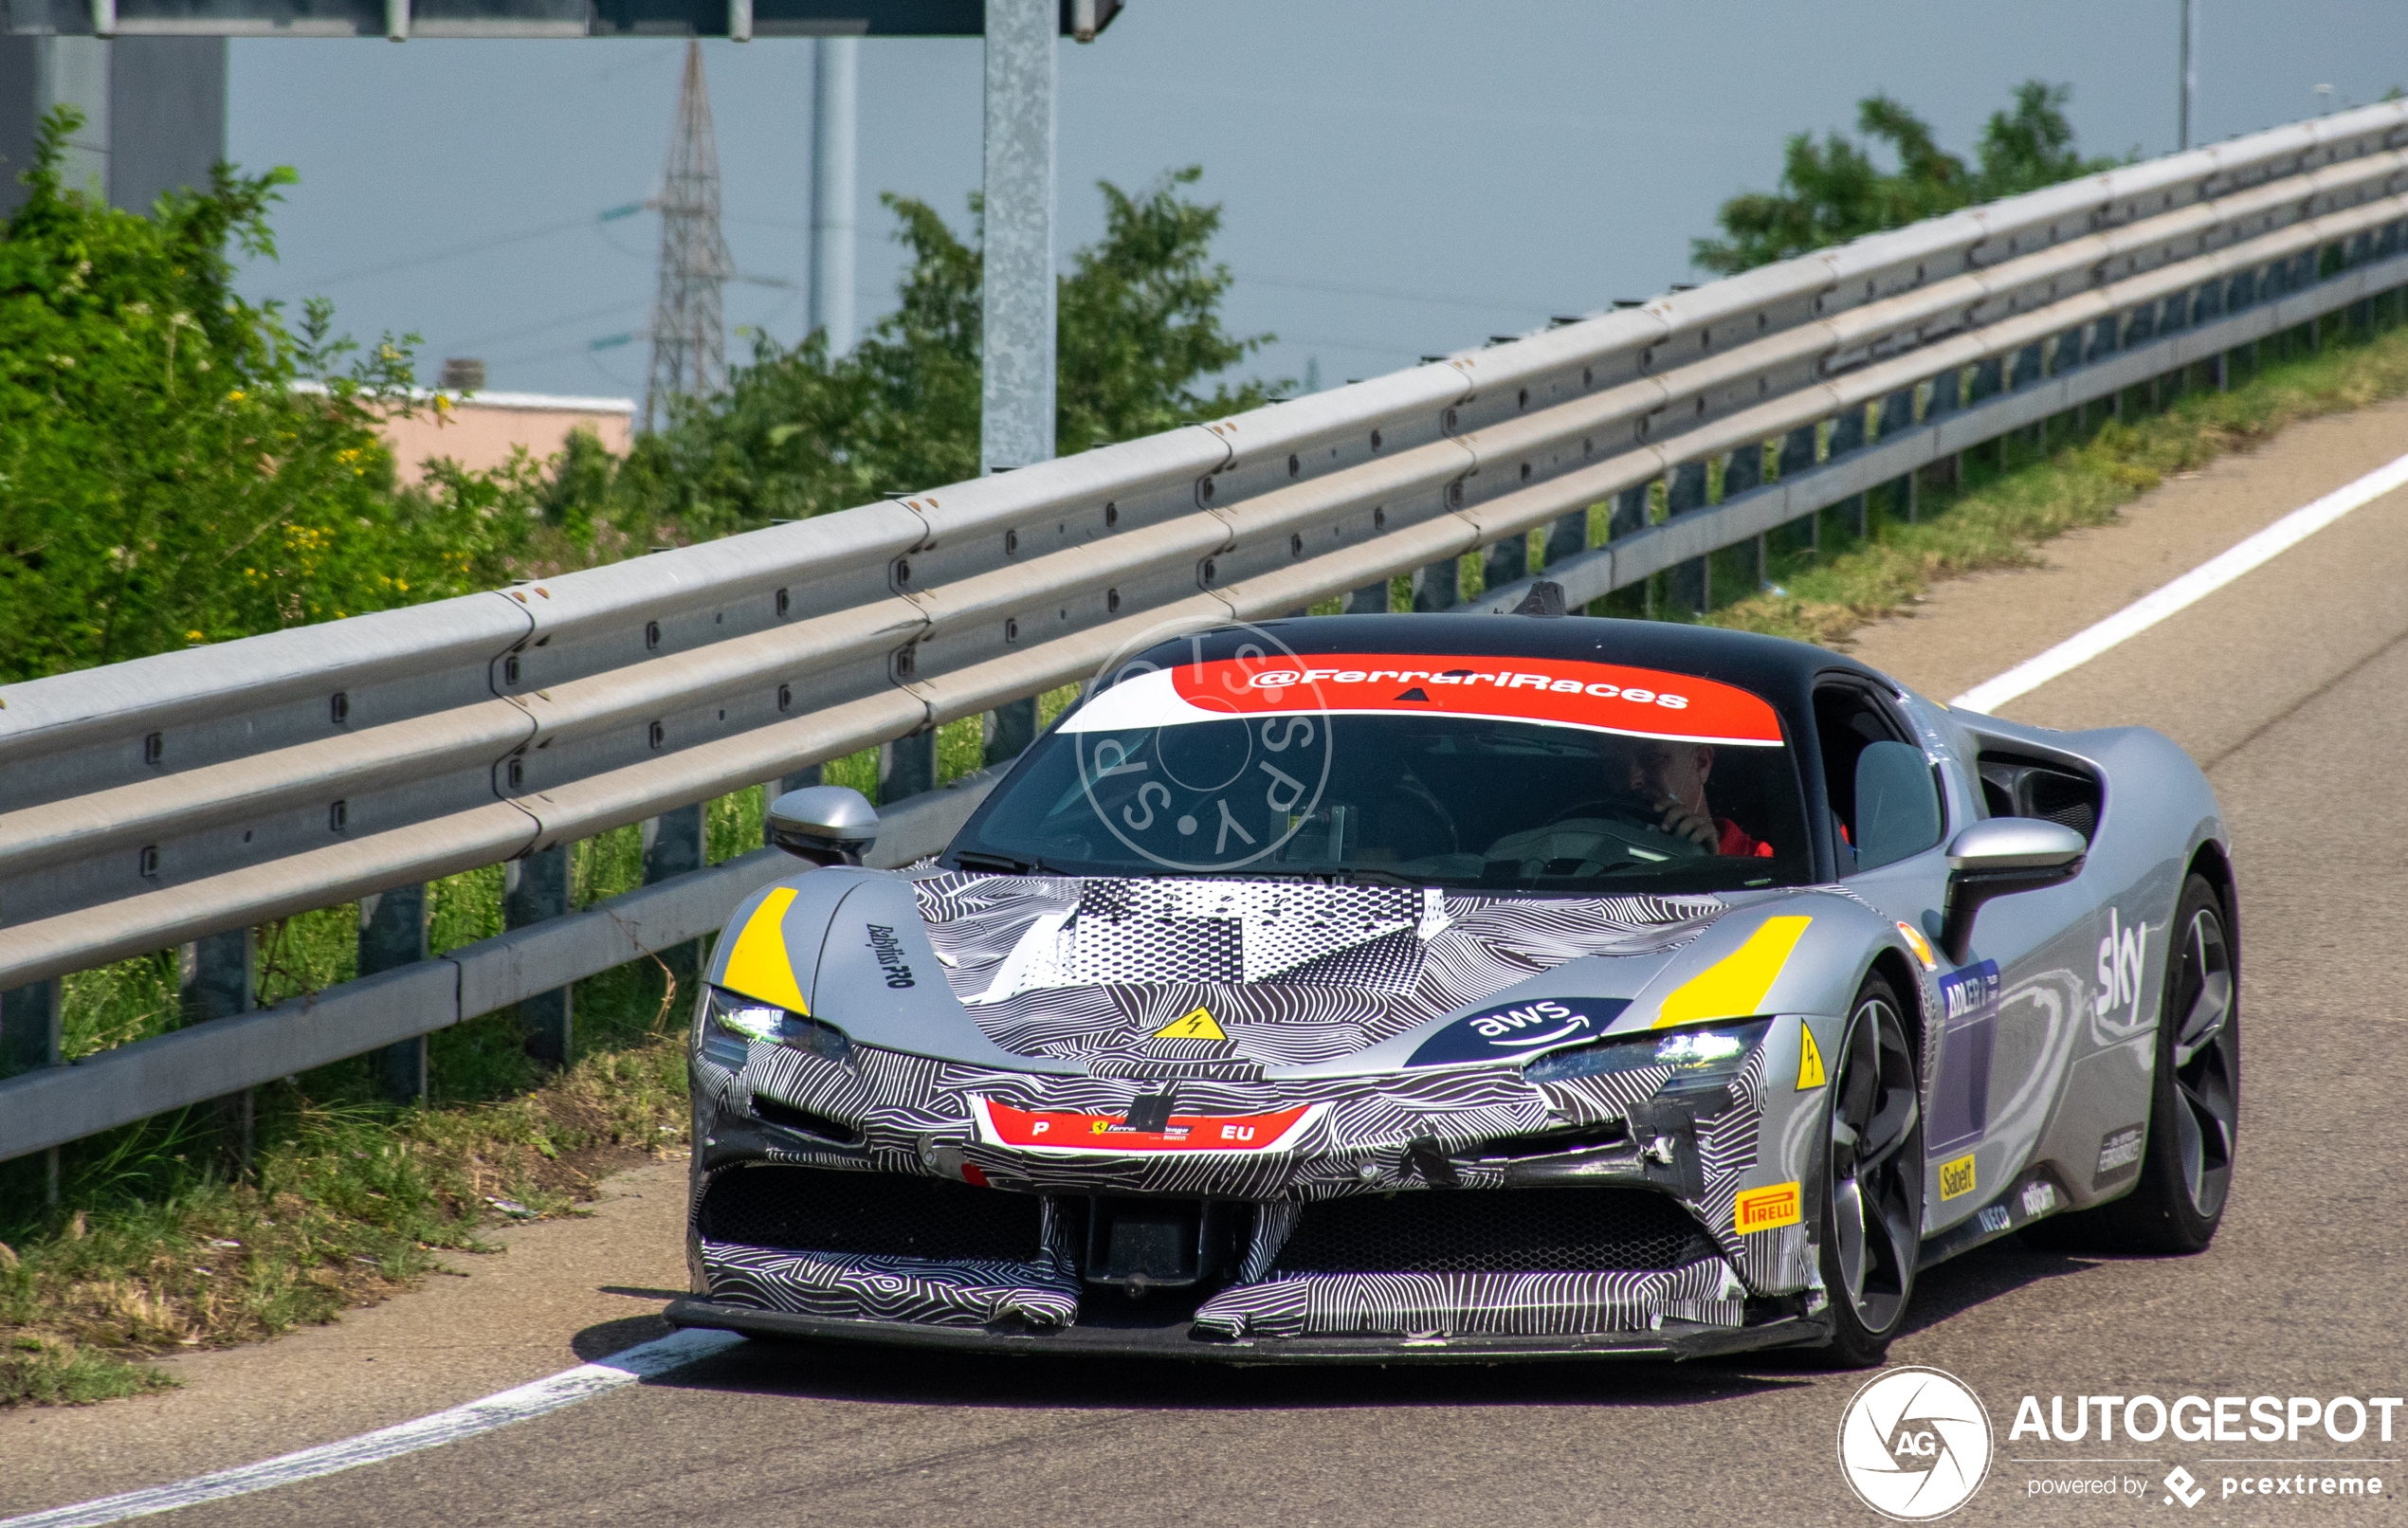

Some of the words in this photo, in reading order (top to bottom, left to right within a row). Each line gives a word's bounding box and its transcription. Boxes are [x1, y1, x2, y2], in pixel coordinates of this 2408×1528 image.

[1249, 668, 1689, 709] @FerrariRaces
[2095, 906, 2147, 1027] sky
[1945, 977, 1980, 1020] ADLER
[1469, 1001, 1571, 1037] aws
[1032, 1119, 1050, 1136] P
[1220, 1125, 1255, 1141] EU
[1943, 1160, 1972, 1197] Sabelt
[1742, 1191, 1795, 1226] PIRELLI
[1978, 1205, 2011, 1232] IVECO
